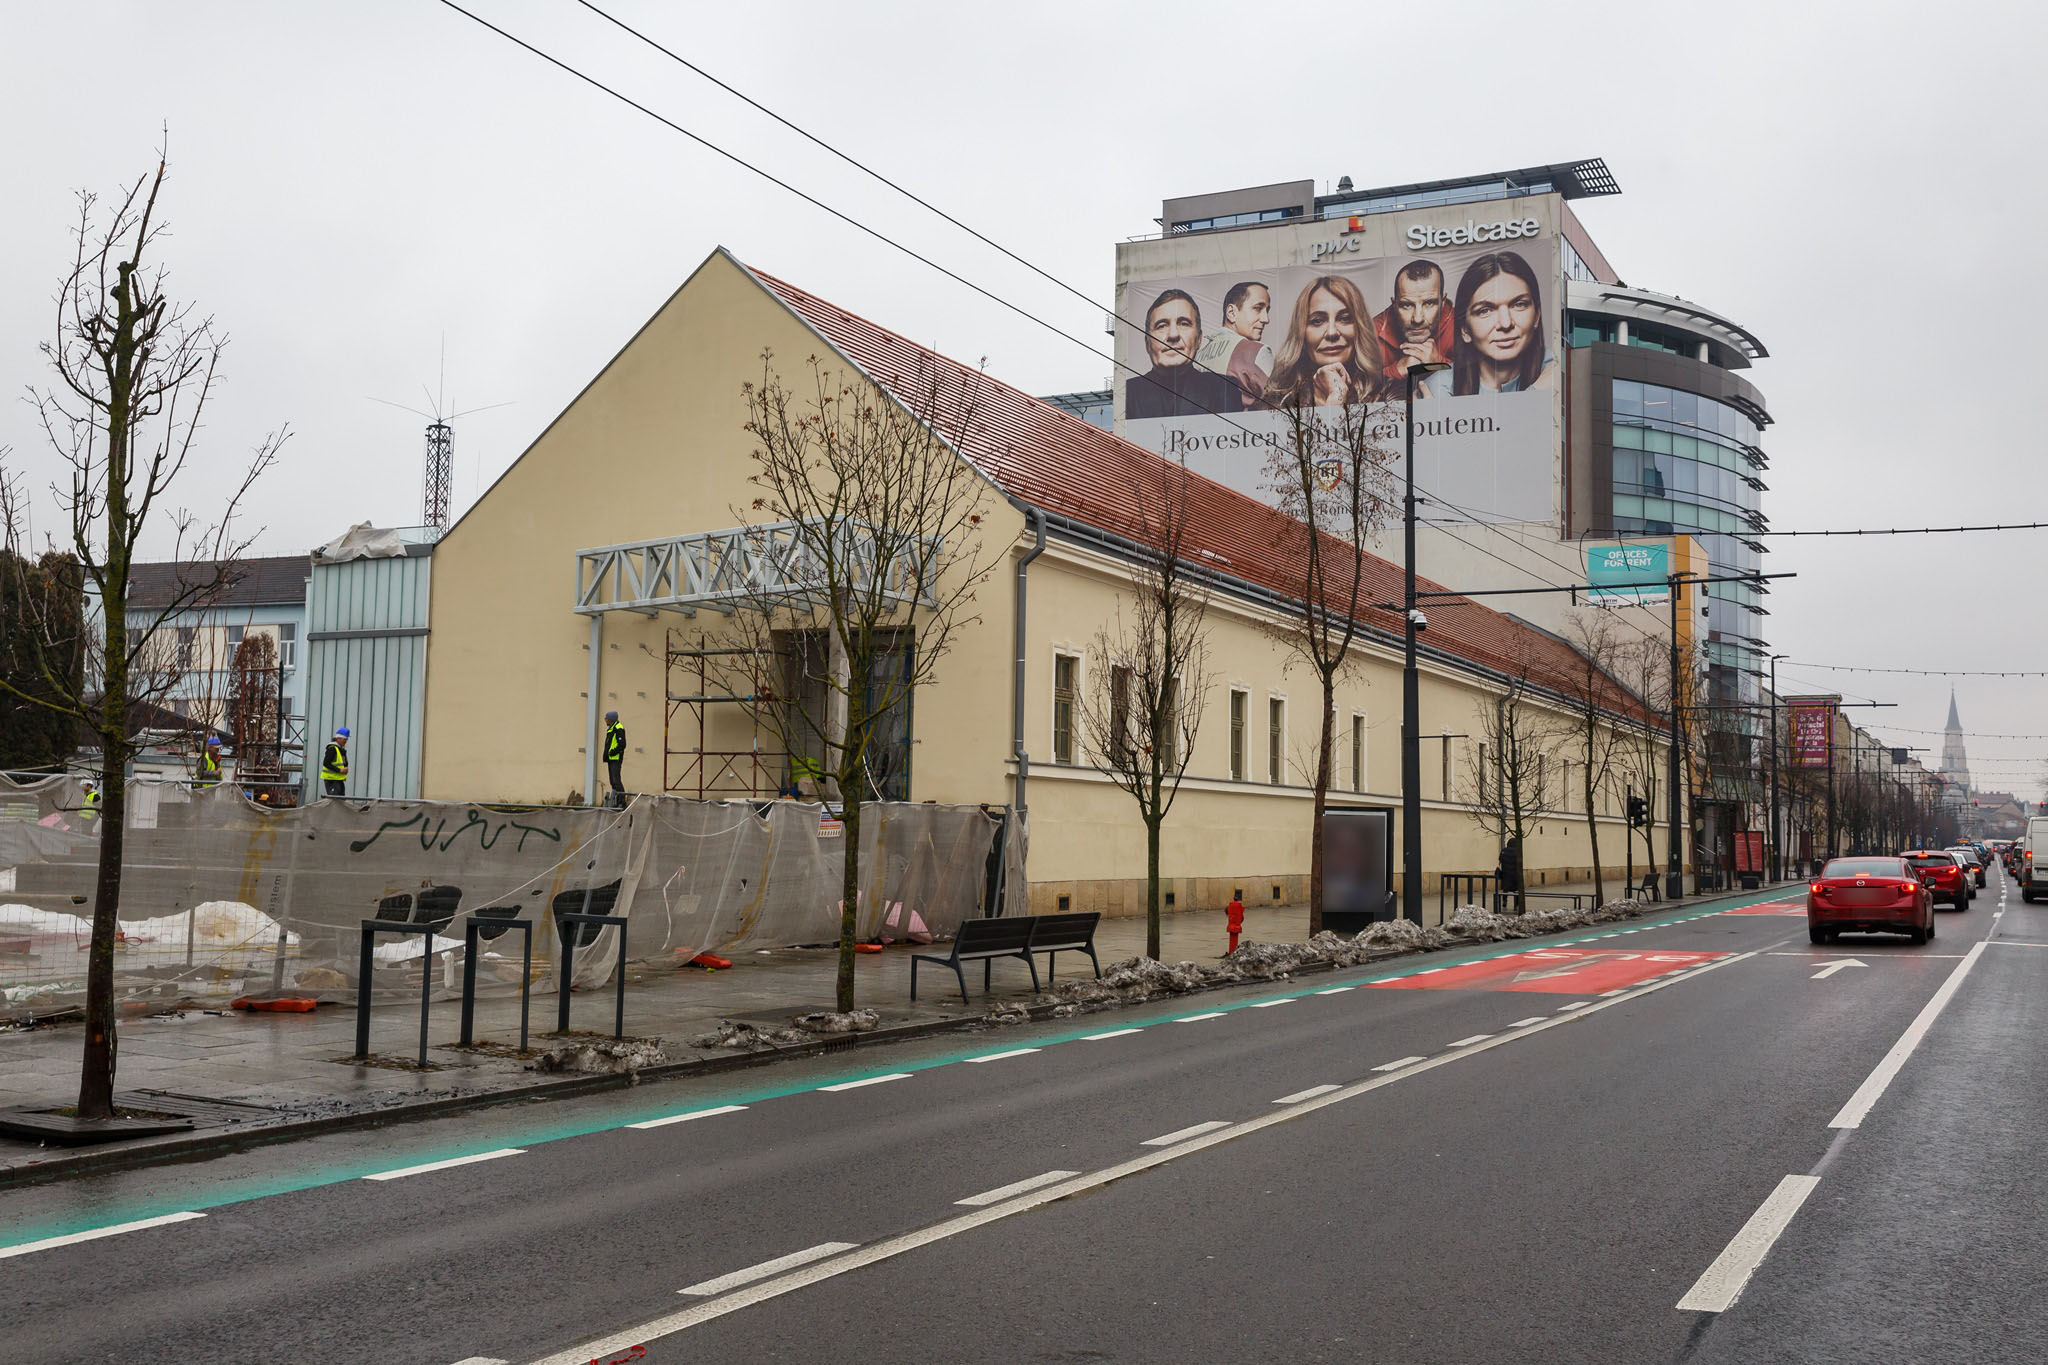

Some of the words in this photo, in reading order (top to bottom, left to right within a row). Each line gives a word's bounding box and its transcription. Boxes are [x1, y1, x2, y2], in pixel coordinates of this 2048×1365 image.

[1407, 217, 1540, 250] Steelcase
[1311, 237, 1360, 261] pwc
[1169, 429, 1278, 452] Povestea
[1372, 419, 1400, 440] că
[1411, 416, 1501, 445] putem.
[1604, 559, 1624, 567] FOR
[1626, 558, 1652, 567] RENT
[1608, 550, 1647, 559] OFFICES
